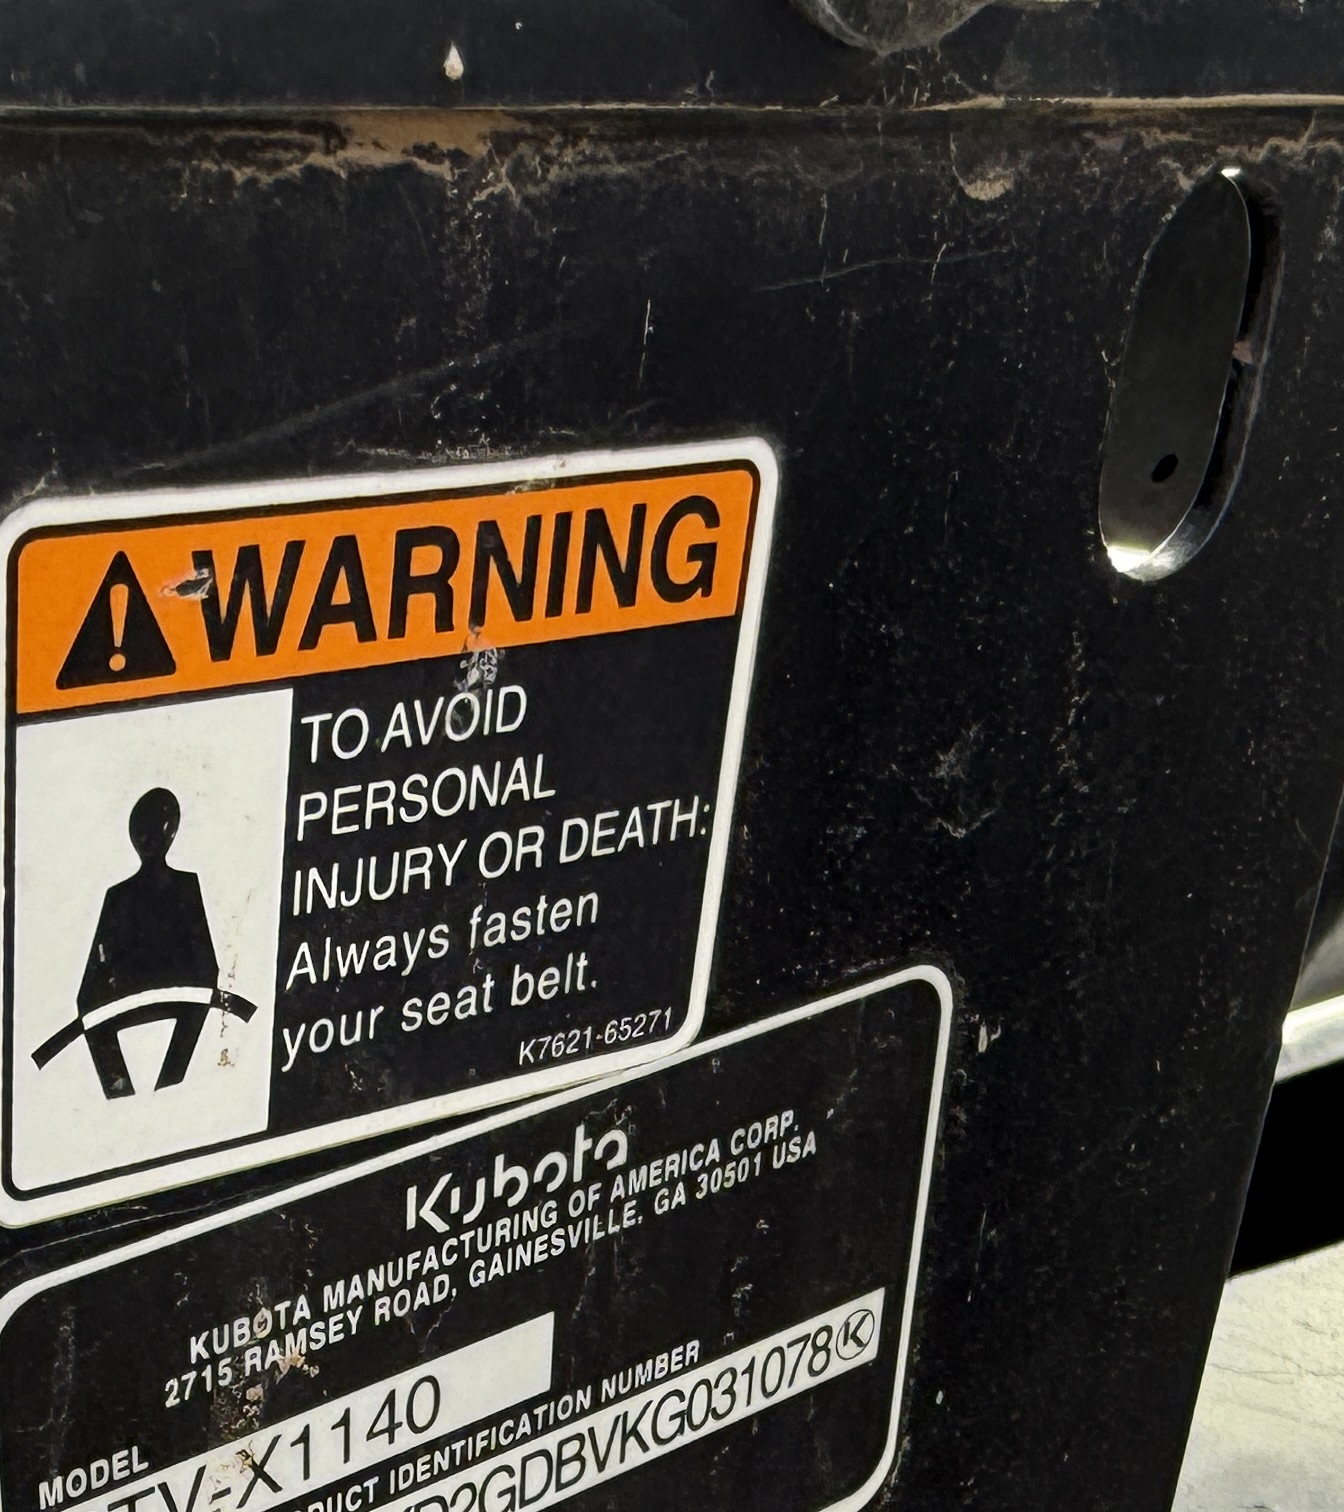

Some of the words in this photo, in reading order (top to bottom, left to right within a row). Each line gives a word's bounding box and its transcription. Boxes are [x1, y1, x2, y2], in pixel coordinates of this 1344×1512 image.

[190, 495, 720, 662] WARNING
[301, 708, 369, 763] TO
[381, 685, 526, 752] AVOID
[297, 754, 555, 841] PERSONAL
[293, 839, 467, 915] INJURY
[479, 826, 544, 878] OR
[560, 796, 709, 863] DEATH:
[286, 924, 449, 990] Always
[470, 893, 598, 949] fasten
[282, 1006, 384, 1072] your
[402, 974, 494, 1031] seat
[511, 953, 596, 1006] belt.
[519, 1007, 671, 1065] K7621-65271
[407, 1125, 627, 1233] Kubota
[165, 1357, 232, 1407] 2715
[245, 1306, 362, 1367] RAMSEY
[375, 1274, 456, 1325] ROAD,
[655, 1182, 685, 1214] GA
[696, 1152, 761, 1199] 30501
[773, 1131, 816, 1168] USA
[191, 1295, 310, 1364] KUBOTA
[324, 1201, 557, 1312] MANUFACTURING
[569, 1183, 601, 1217] OF
[611, 1139, 720, 1202] AMERICA
[731, 1110, 798, 1155] CORP.
[390, 1385, 591, 1494] IDENTIFICATION
[602, 1340, 699, 1402] NUMBER
[39, 1446, 148, 1509] MODEL
